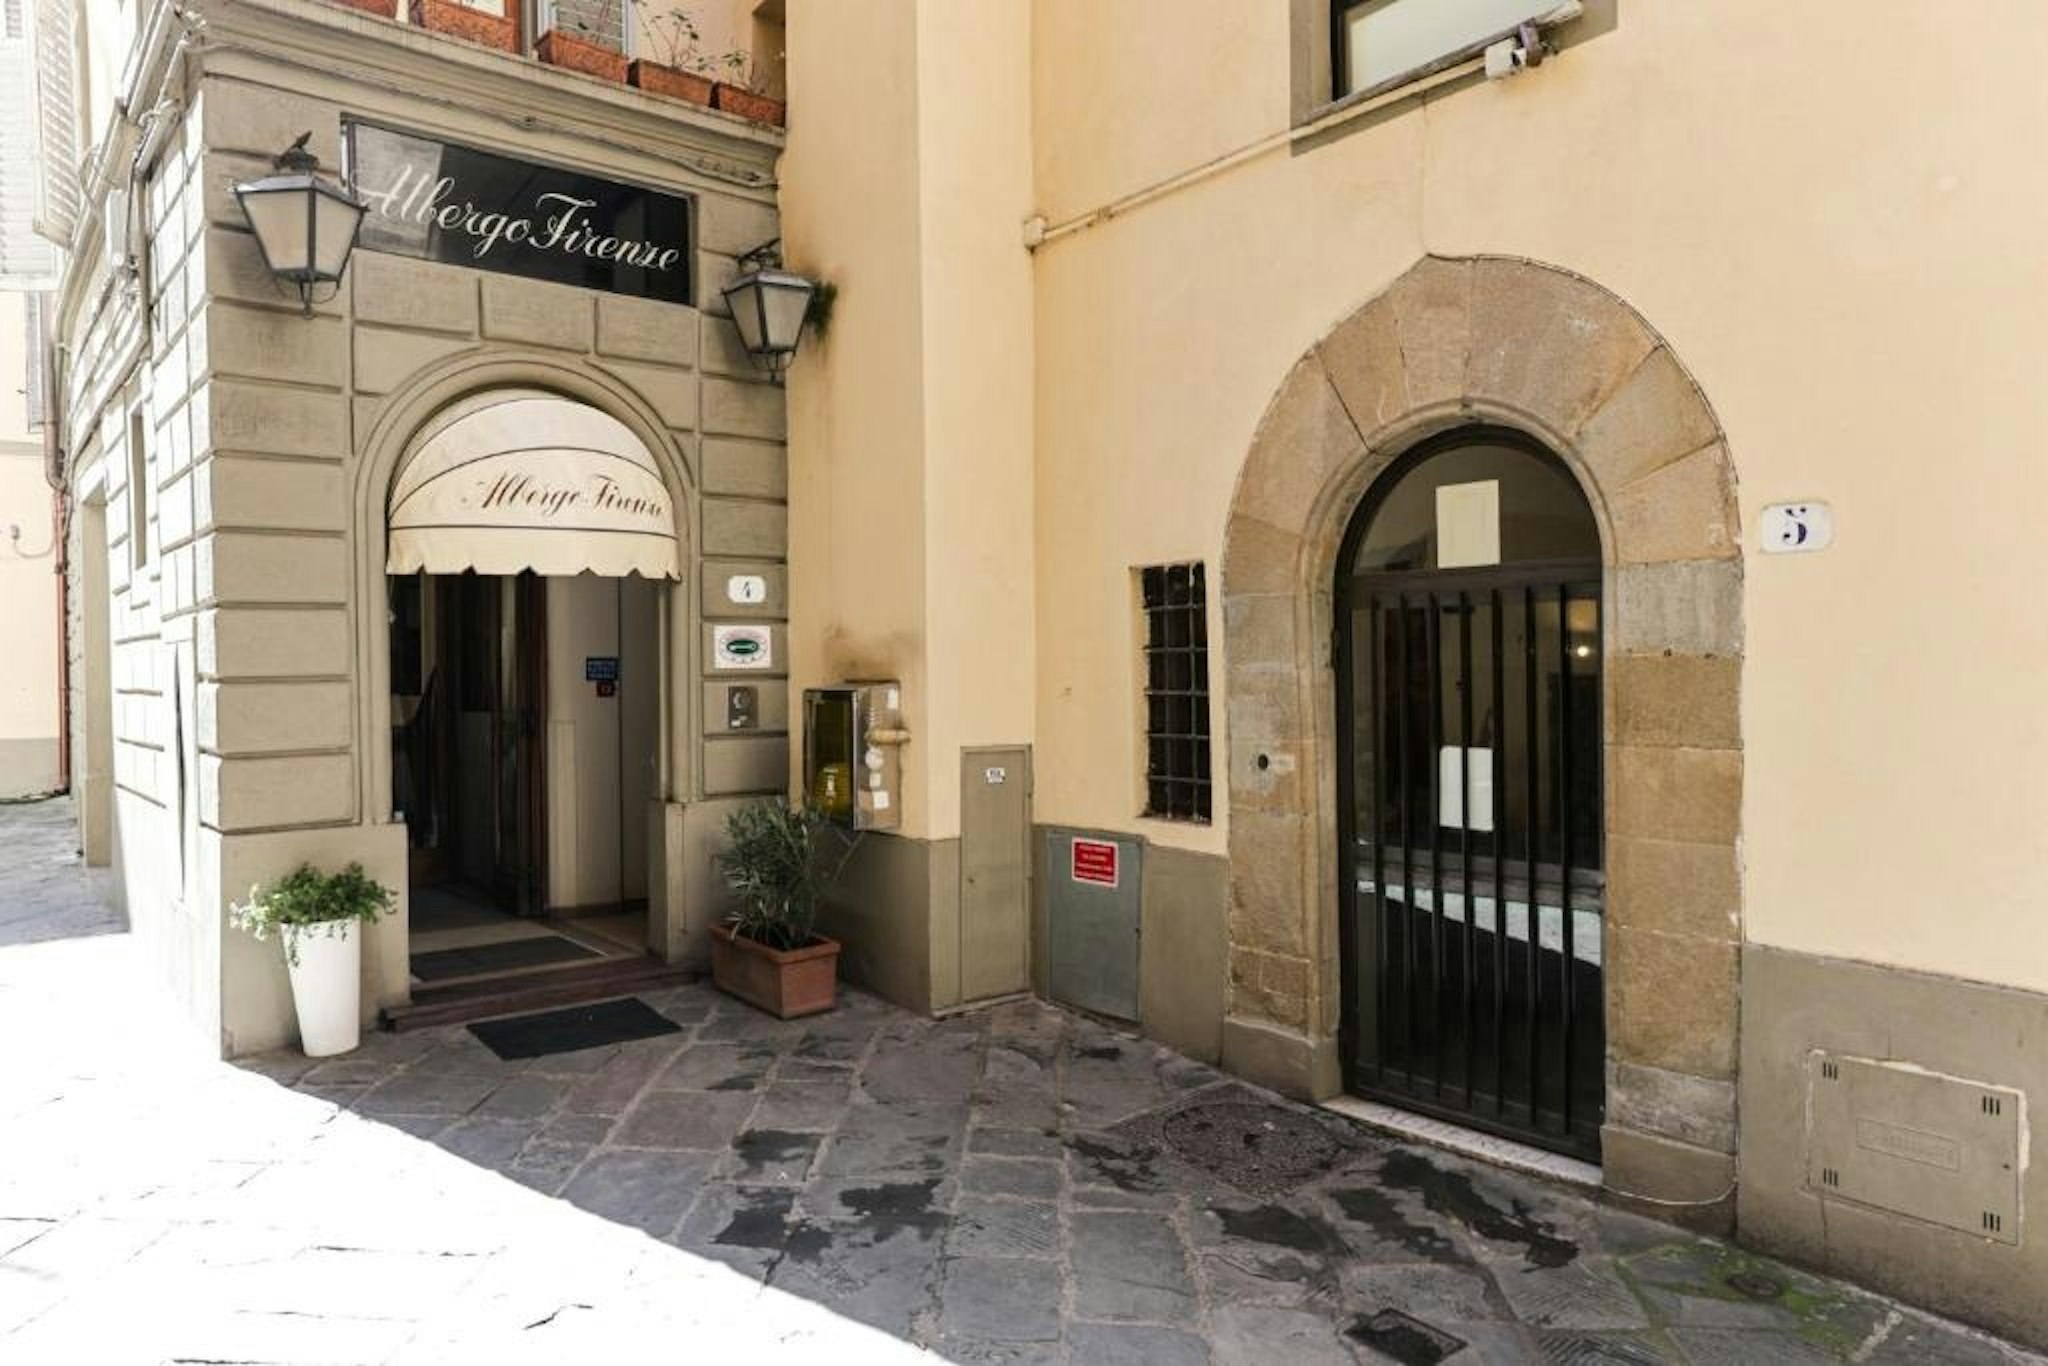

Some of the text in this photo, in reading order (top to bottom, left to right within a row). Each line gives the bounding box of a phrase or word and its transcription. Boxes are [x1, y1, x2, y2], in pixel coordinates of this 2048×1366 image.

[353, 163, 680, 271] Albergo Firenze
[1783, 507, 1807, 546] 5
